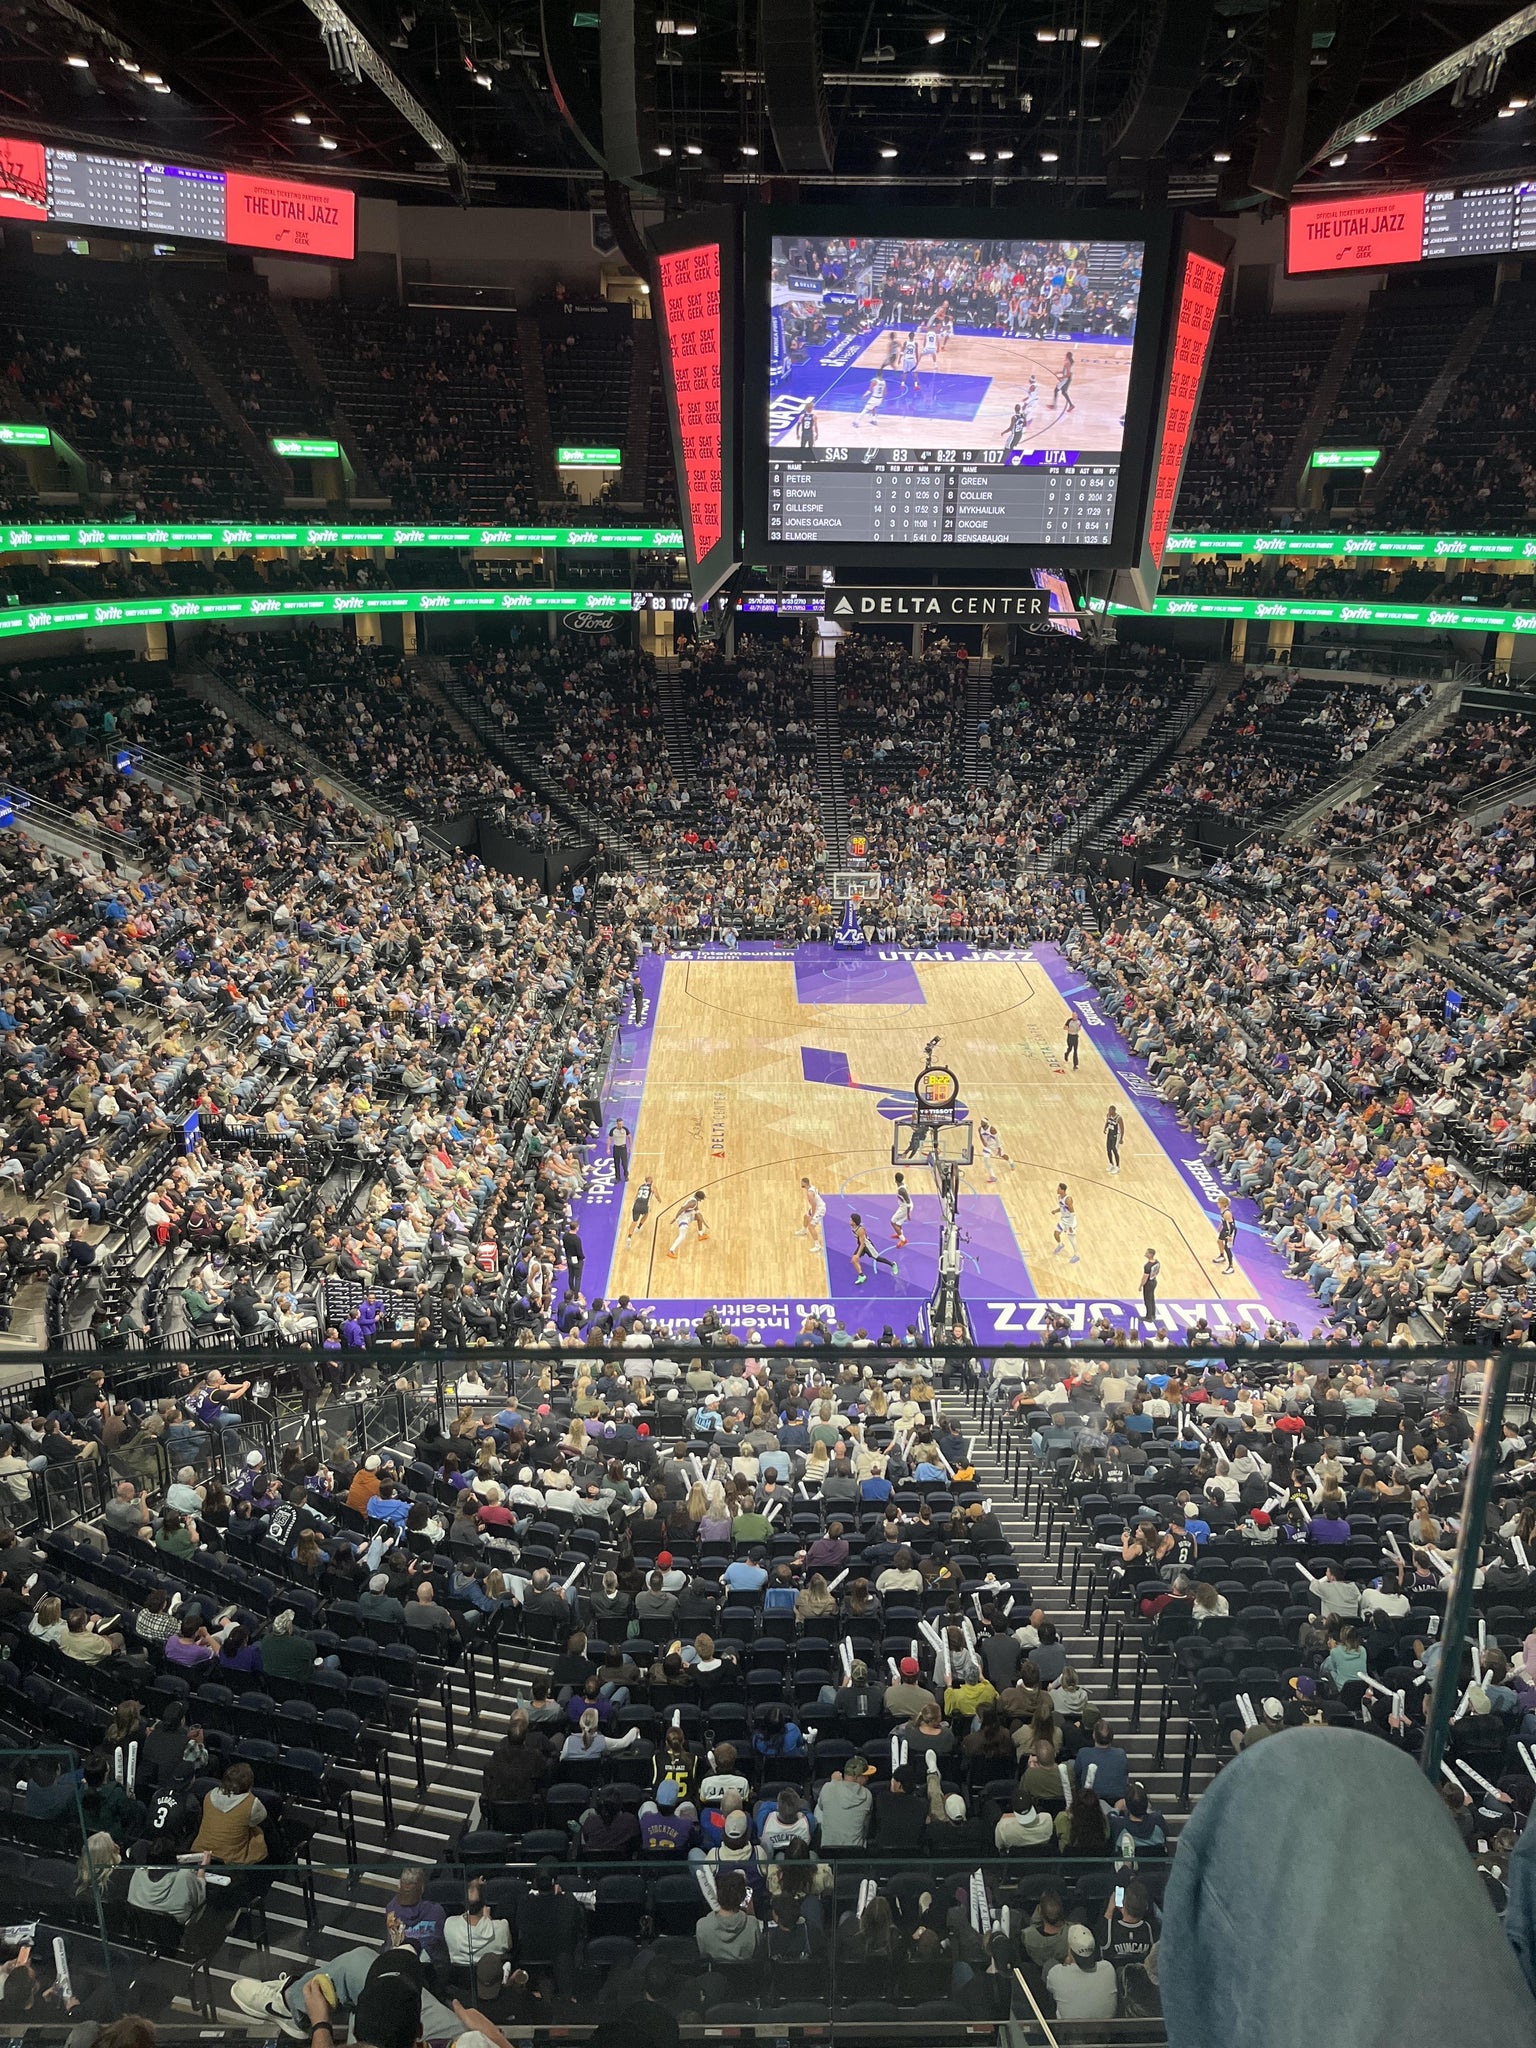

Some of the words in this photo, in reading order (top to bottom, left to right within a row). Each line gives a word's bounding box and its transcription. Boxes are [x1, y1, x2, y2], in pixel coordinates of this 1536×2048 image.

[244, 195, 269, 215] THE
[271, 199, 305, 221] UTAH
[308, 205, 339, 225] JAZZ
[1307, 223, 1331, 241] THE
[1333, 217, 1368, 237] UTAH
[1371, 213, 1405, 234] JAZZ
[675, 260, 689, 272] SEAT
[675, 272, 691, 284] GEEK
[668, 299, 682, 311] SEAT
[669, 310, 685, 322] GEEK
[825, 448, 848, 461] SAS
[893, 450, 908, 462] 83
[937, 450, 956, 462] 8:22
[962, 452, 971, 461] 19
[983, 450, 1003, 463] 107
[1045, 450, 1067, 463] UTA
[774, 475, 780, 483] 8
[876, 477, 882, 485] 0
[891, 477, 897, 485] 0
[906, 477, 911, 485] 0
[934, 477, 940, 485] 0
[949, 477, 954, 485] 5
[1108, 479, 1114, 487] 0
[786, 490, 816, 498] BROWN
[876, 491, 881, 499] 3
[892, 491, 897, 499] 2
[905, 491, 910, 499] 0
[933, 491, 939, 499] 0
[1049, 493, 1054, 501] 9
[1065, 493, 1070, 501] 3
[773, 504, 780, 512] 17
[786, 504, 824, 512] GILLESPIE
[933, 506, 938, 514] 3
[959, 506, 1006, 514] MYKHAILIUK
[1048, 507, 1054, 515] 7
[771, 518, 781, 526] 25
[785, 518, 812, 526] JONES
[813, 519, 842, 527] GARCIA
[890, 520, 895, 528] 3
[903, 520, 909, 528] 0
[933, 520, 937, 528] 1
[945, 520, 953, 528] 21
[1046, 522, 1052, 530] 5
[1062, 522, 1068, 530] 0
[1077, 522, 1081, 530] 1
[1105, 522, 1109, 530] 1
[10, 530, 32, 547] Sprite
[222, 530, 252, 544] Sprite
[307, 530, 338, 544] Sprite
[480, 531, 512, 544] Sprite
[771, 532, 781, 540] 33
[785, 532, 818, 540] ELMORE
[874, 533, 880, 541] 0
[890, 533, 894, 541] 1
[904, 533, 908, 541] 1
[943, 534, 953, 542] 28
[1076, 536, 1080, 544] 1
[1102, 536, 1108, 544] 5
[1254, 538, 1286, 551] Sprite
[1434, 540, 1467, 554] Sprite
[250, 599, 281, 614] Sprite
[502, 595, 532, 608] Sprite
[652, 598, 665, 610] 83
[671, 598, 688, 610] 107
[861, 597, 941, 613] DELTA
[951, 597, 1042, 614] CENTER
[1166, 601, 1198, 615] Sprite
[95, 607, 122, 623] Sprite
[574, 612, 614, 629] Ford
[1427, 610, 1459, 625] Sprite
[697, 950, 795, 958] Intermountain
[879, 951, 954, 961] UTAH
[961, 951, 1038, 962] JAZZ
[712, 1124, 725, 1149] DELTA
[713, 1304, 788, 1316] Health
[1178, 1548, 1189, 1564] 8
[709, 1787, 744, 1796] JAZ
[157, 1796, 178, 1808] GEORGE
[153, 1806, 168, 1828] 3
[647, 1824, 679, 1838] STOCKTON
[1114, 1942, 1150, 1953] DUNCAN
